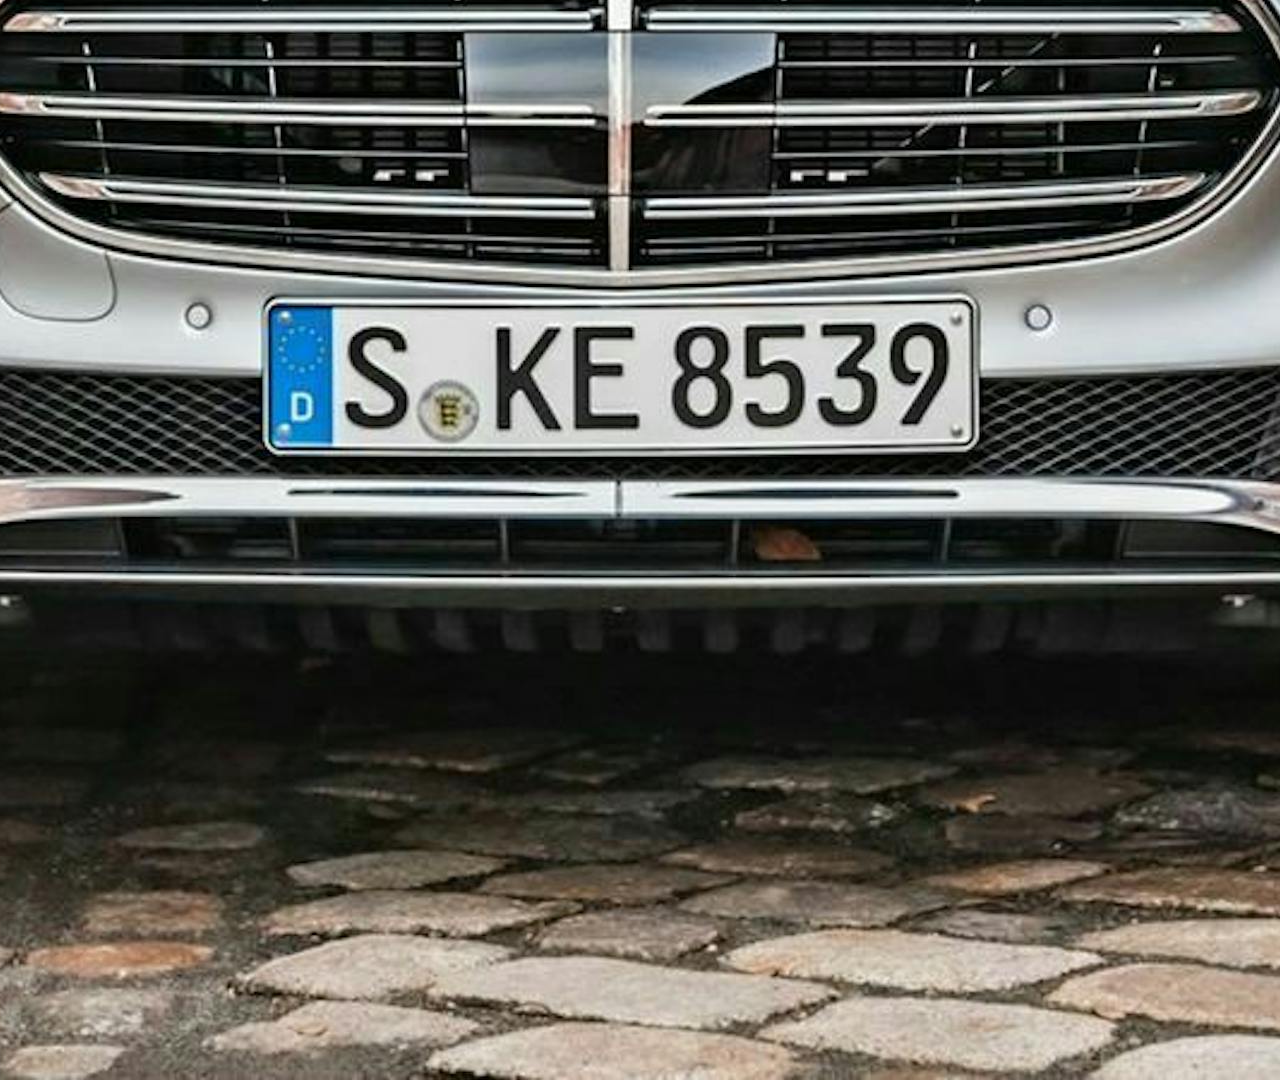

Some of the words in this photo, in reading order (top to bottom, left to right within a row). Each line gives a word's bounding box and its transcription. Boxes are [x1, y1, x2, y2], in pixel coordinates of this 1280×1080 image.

[289, 391, 314, 423] D
[345, 326, 408, 430] S
[495, 326, 640, 431] KE
[671, 322, 950, 429] 8539
